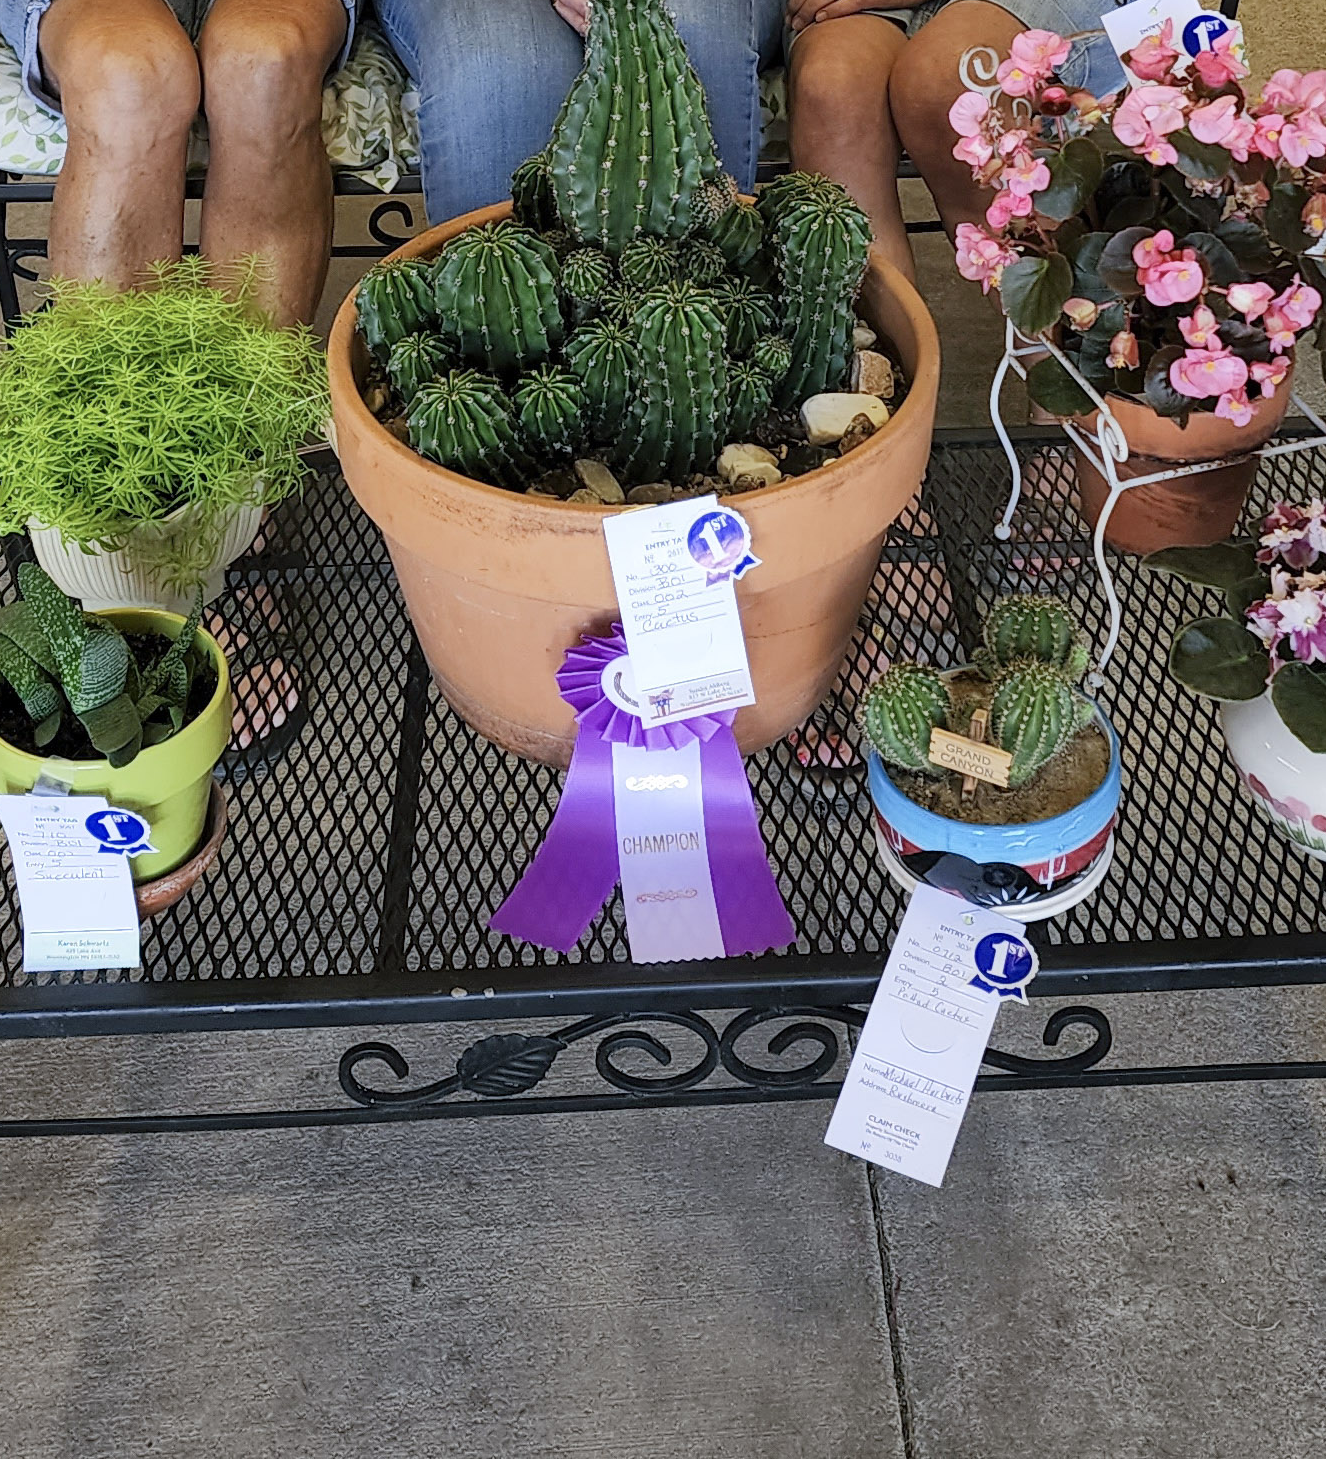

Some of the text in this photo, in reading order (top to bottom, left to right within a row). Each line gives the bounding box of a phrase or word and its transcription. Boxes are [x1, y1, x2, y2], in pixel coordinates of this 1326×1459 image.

[1193, 20, 1221, 52] 1ST
[645, 539, 670, 551] ENTRY
[699, 514, 727, 565] 1ST
[628, 585, 656, 596] Division
[631, 600, 649, 609] Class
[634, 613, 653, 622] Entry
[642, 611, 699, 633] Cactus
[945, 743, 991, 766] GRAND
[940, 752, 994, 778] CANYON
[98, 814, 129, 842] 1ST
[623, 831, 700, 855] CHAMPION
[34, 867, 104, 880] Succulent
[939, 924, 965, 939] ENTRY
[903, 950, 930, 966] Division
[986, 940, 1028, 979] 1ST
[898, 963, 916, 974] Class
[894, 976, 912, 989] Entry
[858, 1077, 887, 1095] Address
[868, 1114, 893, 1129] CLAIM
[893, 1123, 921, 1140] CHECK
